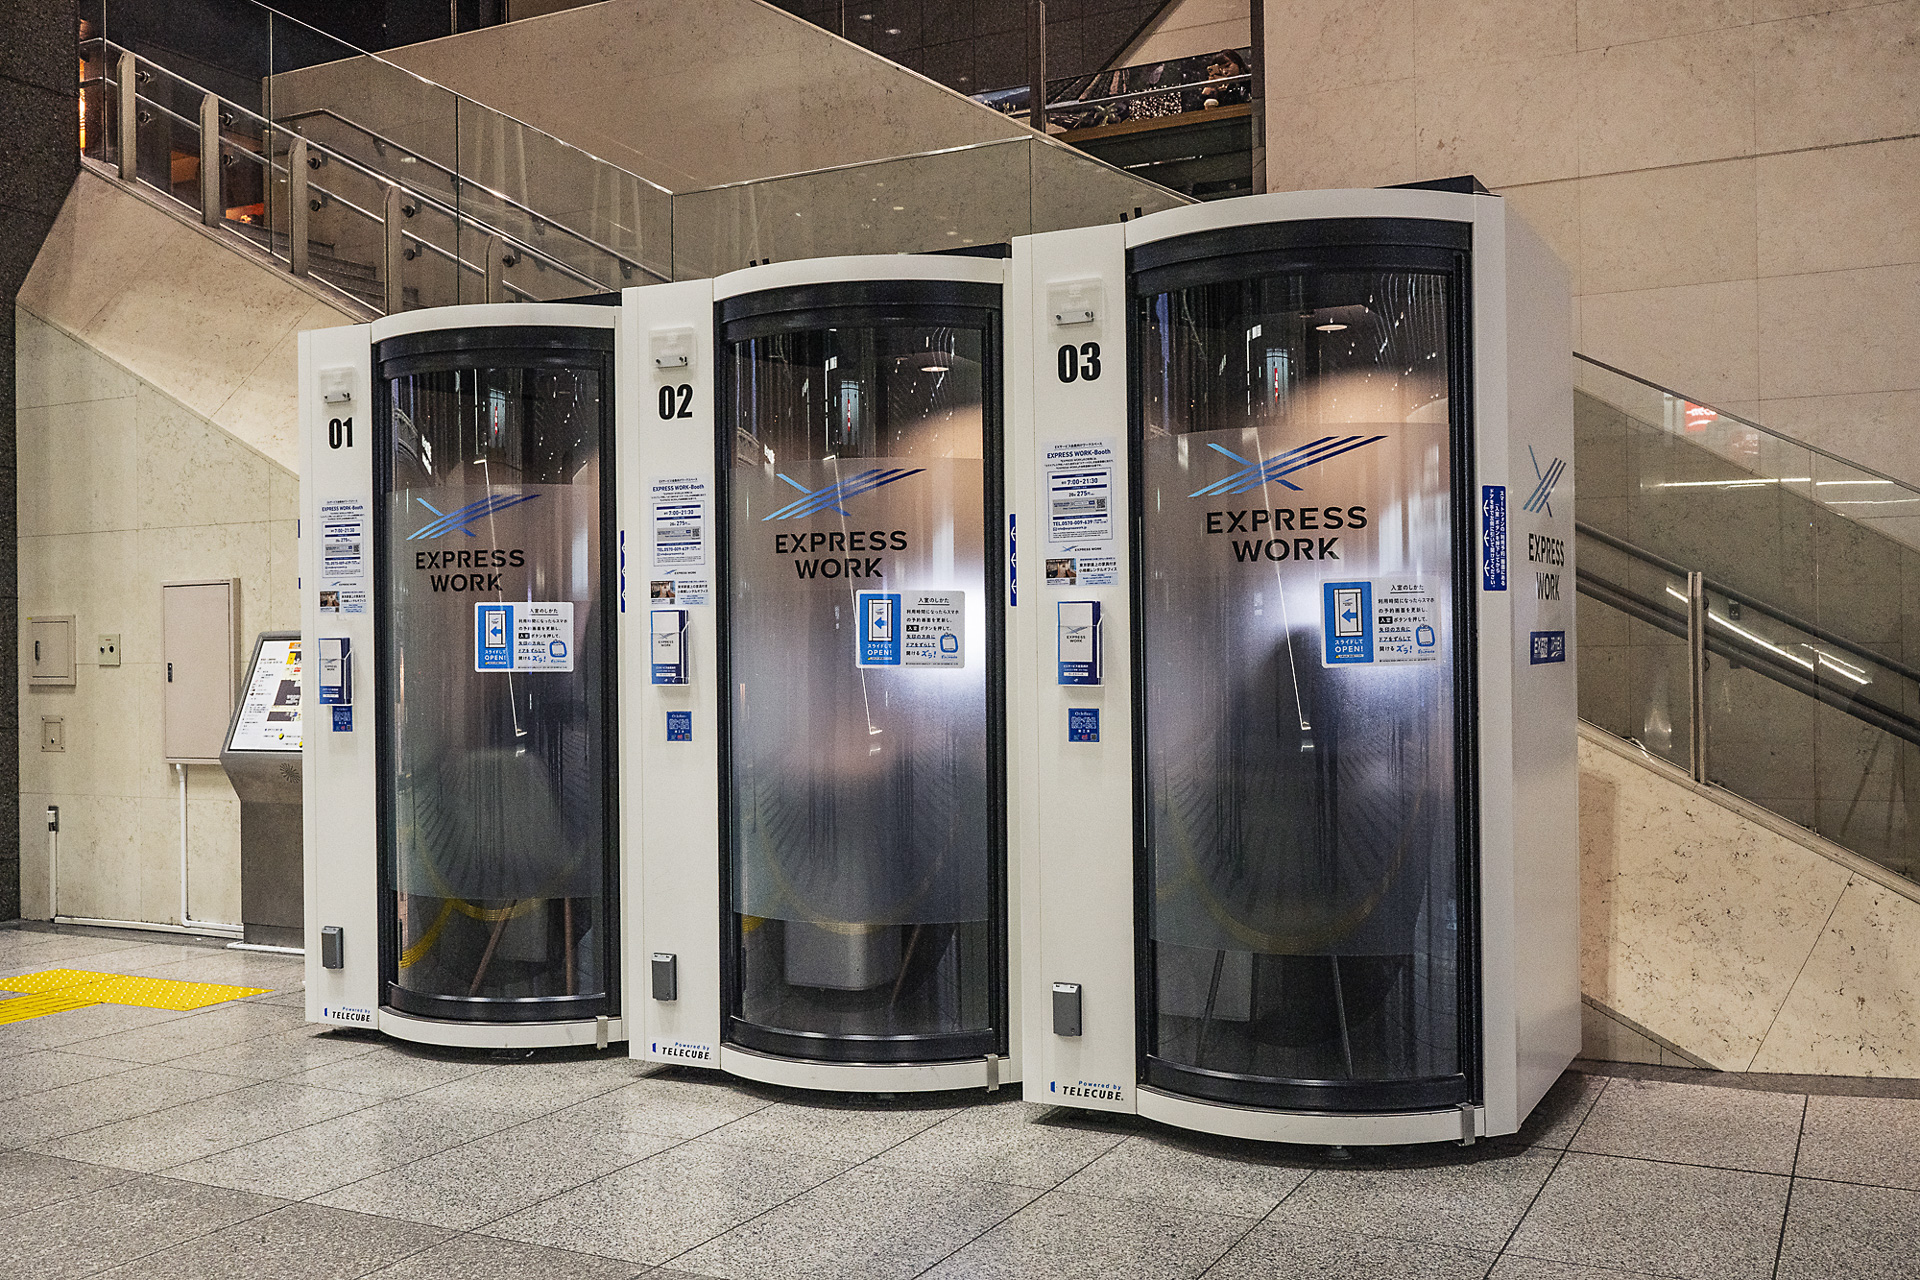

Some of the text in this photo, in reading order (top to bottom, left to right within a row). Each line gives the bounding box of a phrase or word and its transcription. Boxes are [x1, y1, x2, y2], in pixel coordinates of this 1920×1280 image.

[1058, 342, 1101, 383] 03
[659, 384, 693, 420] 02
[329, 417, 352, 449] 01
[1047, 449, 1111, 459] EXPRESS WORK-Booth
[1207, 506, 1367, 533] EXPRESS
[775, 531, 907, 553] EXPRESS
[1232, 538, 1340, 562] WORK
[1528, 533, 1564, 567] EXPRESS
[416, 549, 525, 569] EXPRESS
[795, 558, 883, 578] WORK
[430, 573, 503, 592] WORK
[1536, 572, 1560, 600] WORK
[1078, 1080, 1110, 1089] Powered
